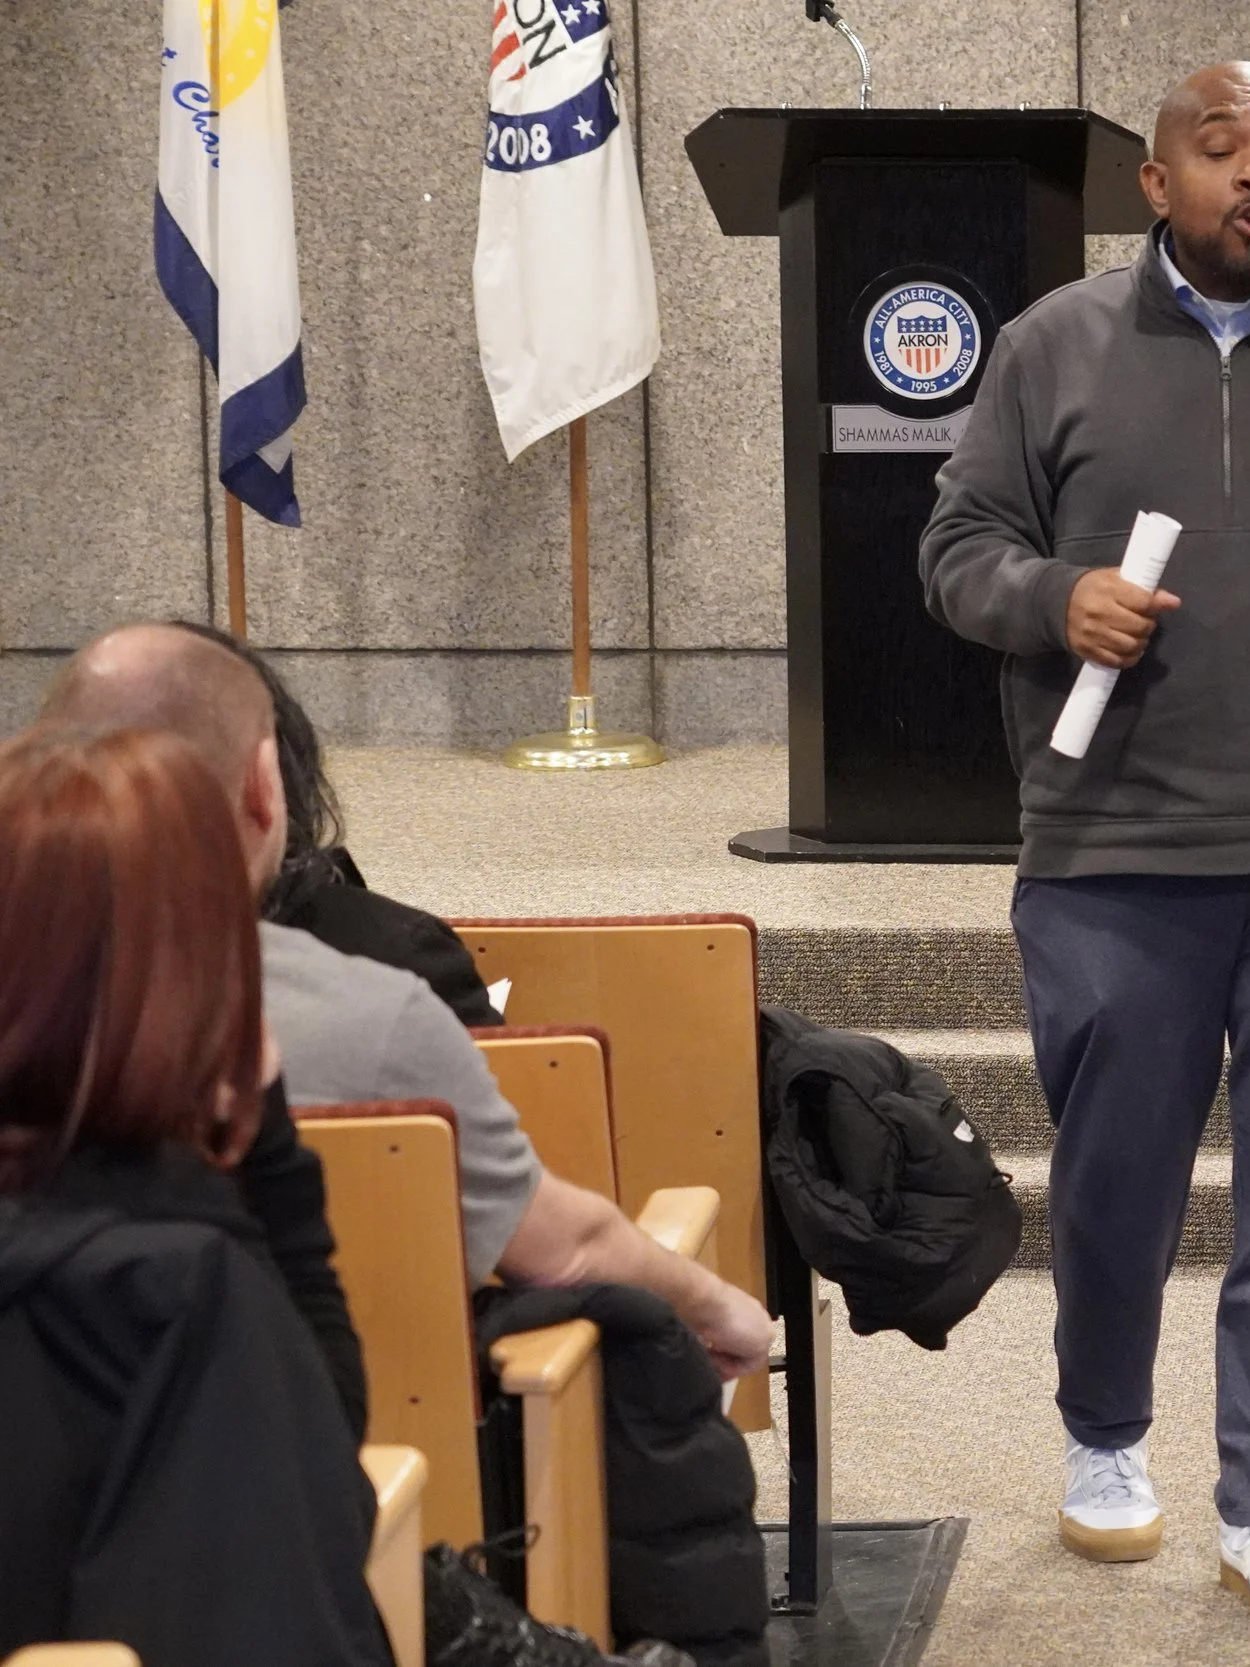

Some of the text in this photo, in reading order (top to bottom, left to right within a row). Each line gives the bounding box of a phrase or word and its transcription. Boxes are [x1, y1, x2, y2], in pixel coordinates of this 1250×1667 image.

[486, 122, 552, 165] 2008
[875, 289, 971, 329] ALL-AMERICA CITY
[898, 334, 948, 347] AKRON
[874, 352, 893, 376] 1981
[953, 349, 973, 377] 2008
[911, 380, 937, 392] 1995
[839, 427, 909, 442] SHAMMAS
